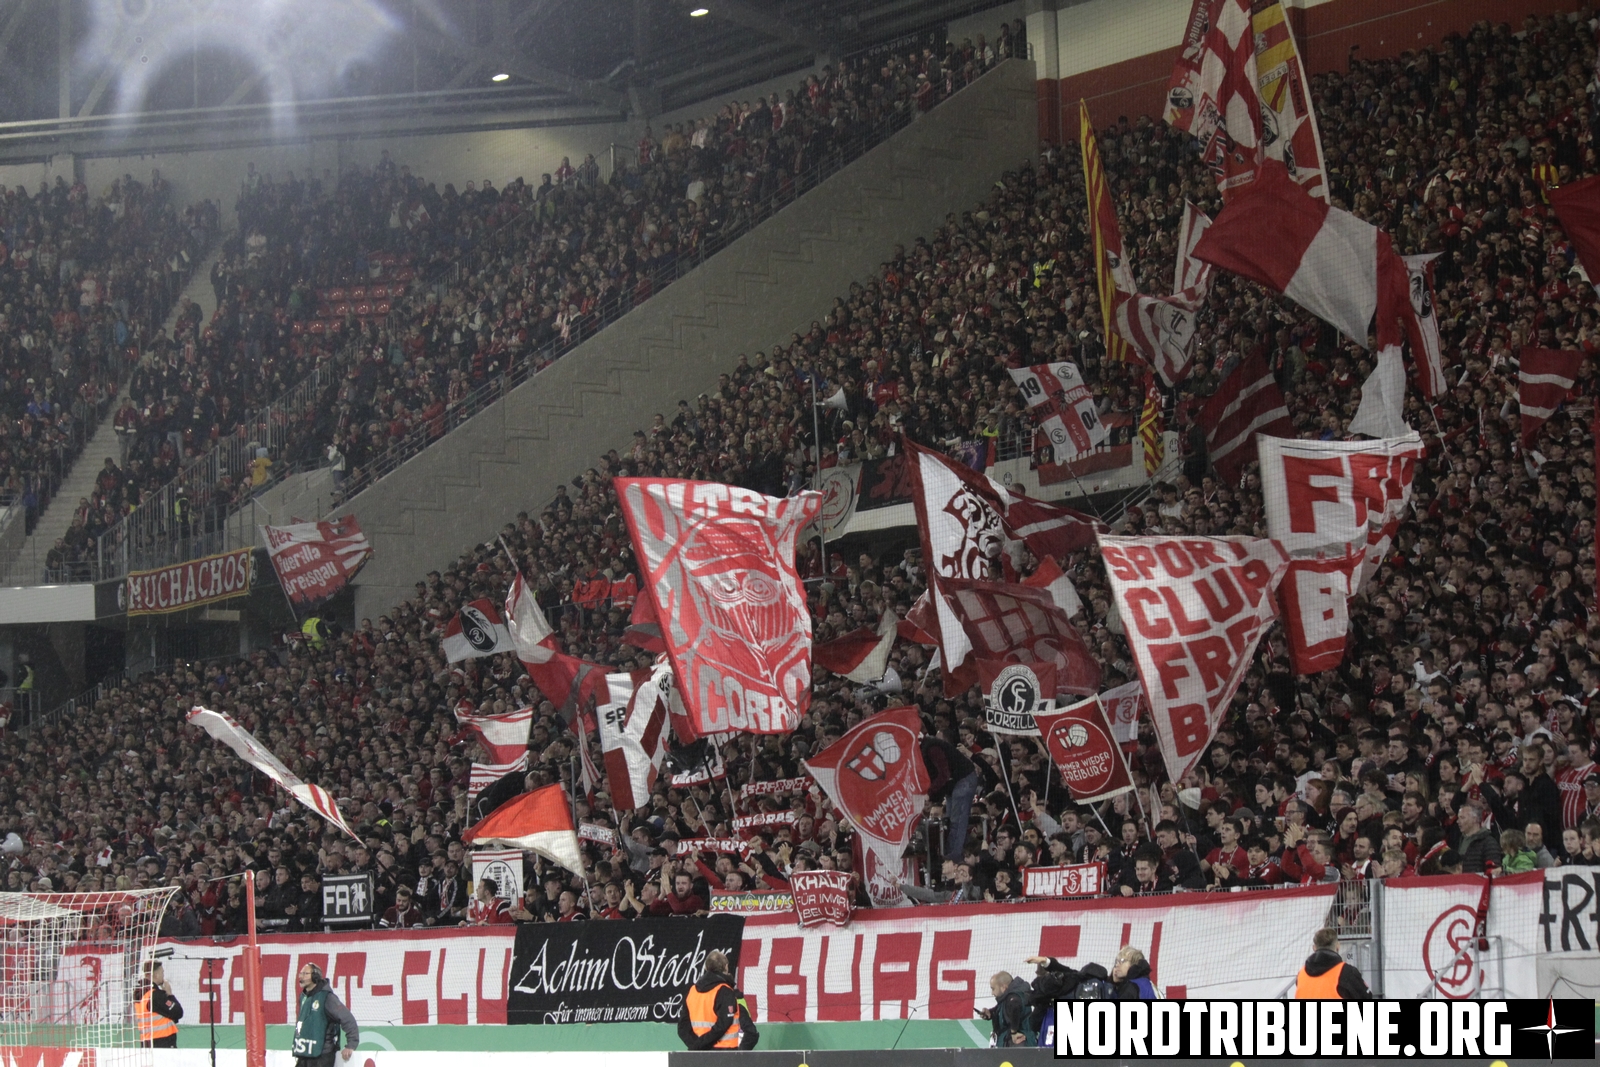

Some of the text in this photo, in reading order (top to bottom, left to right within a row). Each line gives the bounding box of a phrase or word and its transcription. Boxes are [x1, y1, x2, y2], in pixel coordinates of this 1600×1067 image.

[1019, 377, 1041, 398] 19
[128, 552, 247, 610] MUCHACHOS
[1081, 751, 1110, 768] WIEDER
[1063, 762, 1108, 782] FREIBURG
[863, 789, 904, 828] IMMER
[513, 938, 612, 994] Achim
[574, 1004, 604, 1022] immer
[604, 1003, 615, 1021] in
[615, 1005, 649, 1022] unserm
